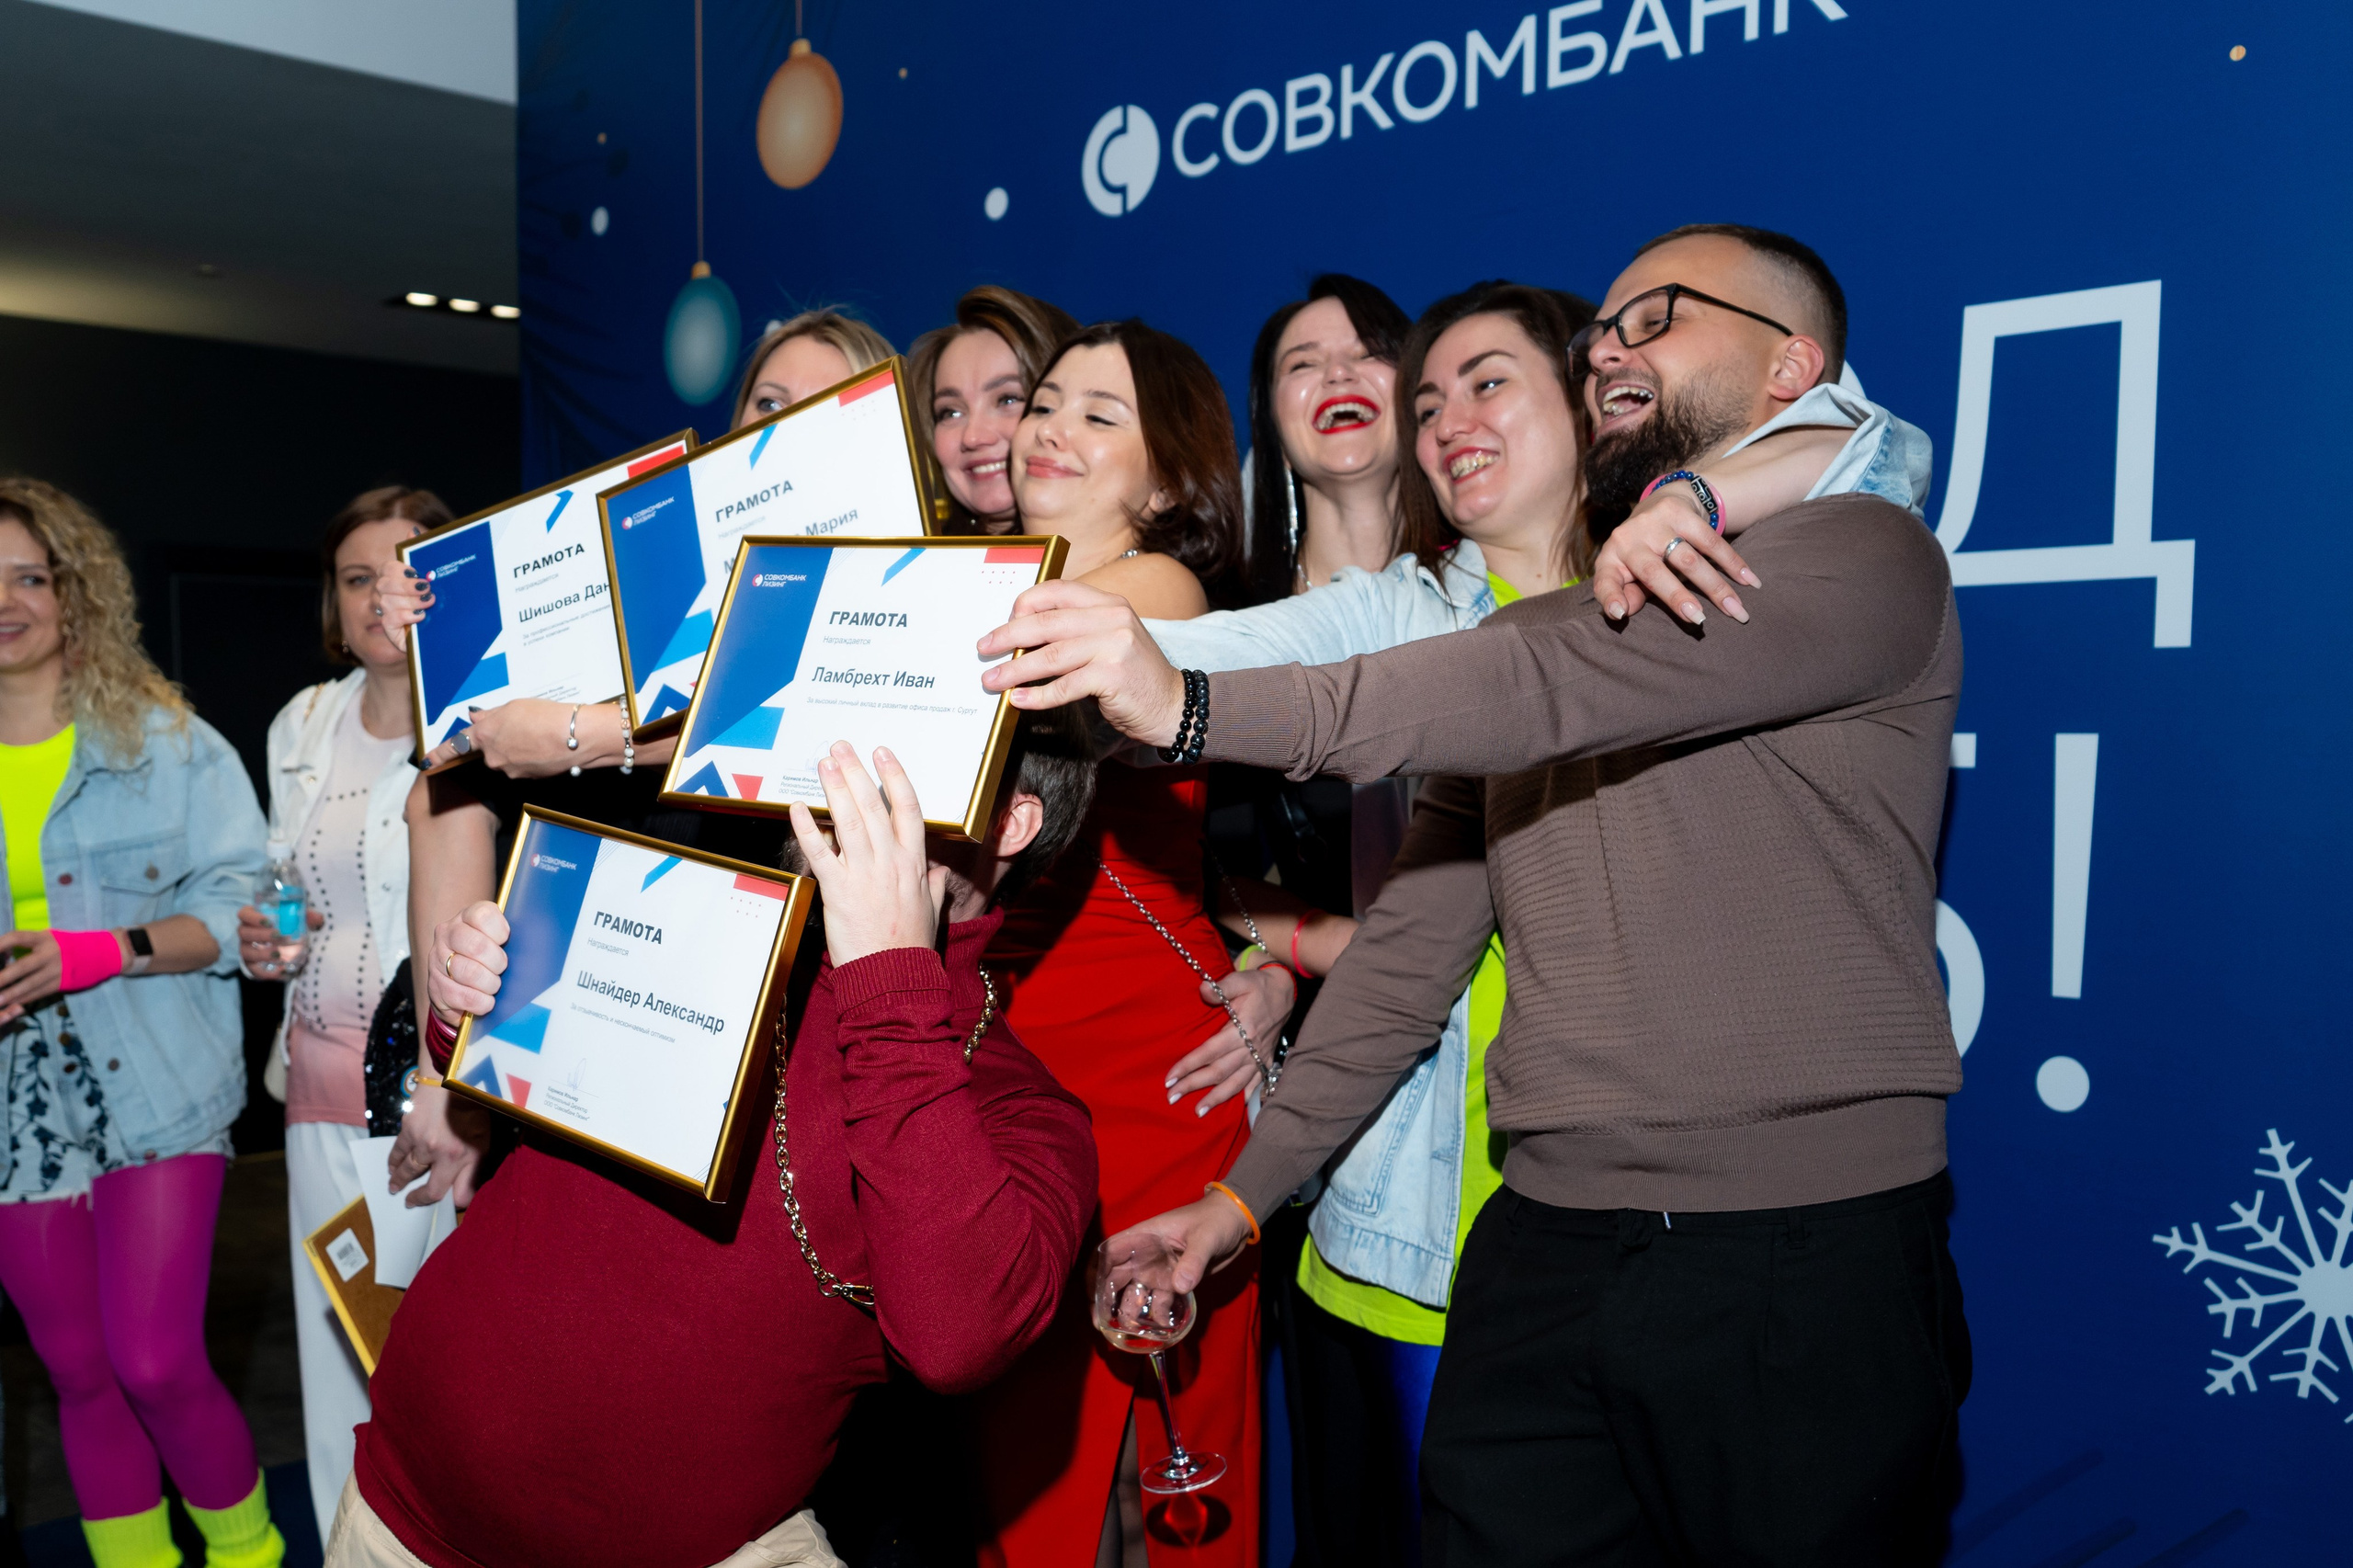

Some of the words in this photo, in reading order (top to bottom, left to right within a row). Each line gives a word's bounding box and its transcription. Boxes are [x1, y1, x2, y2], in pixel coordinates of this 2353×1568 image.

[715, 480, 793, 523] ГРАМОТА
[805, 509, 858, 537] Мария
[513, 543, 585, 579] ГРАМОТА
[515, 573, 559, 594] Награждается
[762, 580, 787, 588] ЛИЗИНГ
[764, 574, 807, 582] СОВКОМБАНК
[519, 593, 581, 623] Шишова
[829, 610, 908, 628] ГРАМОТА
[823, 635, 871, 645] Награждается
[812, 666, 891, 688] Ламбрехт
[892, 670, 936, 688] Иван
[881, 702, 908, 710] развитие
[908, 703, 928, 712] офиса
[928, 704, 951, 712] продаж
[957, 706, 978, 716] Сургут
[593, 911, 664, 945] ГРАМОТА
[586, 937, 630, 957] Награждается
[576, 970, 642, 1008] Шнайдер
[642, 992, 725, 1035] Александр
[614, 1017, 651, 1035] нескончаемый
[650, 1030, 676, 1043] оптимизм
